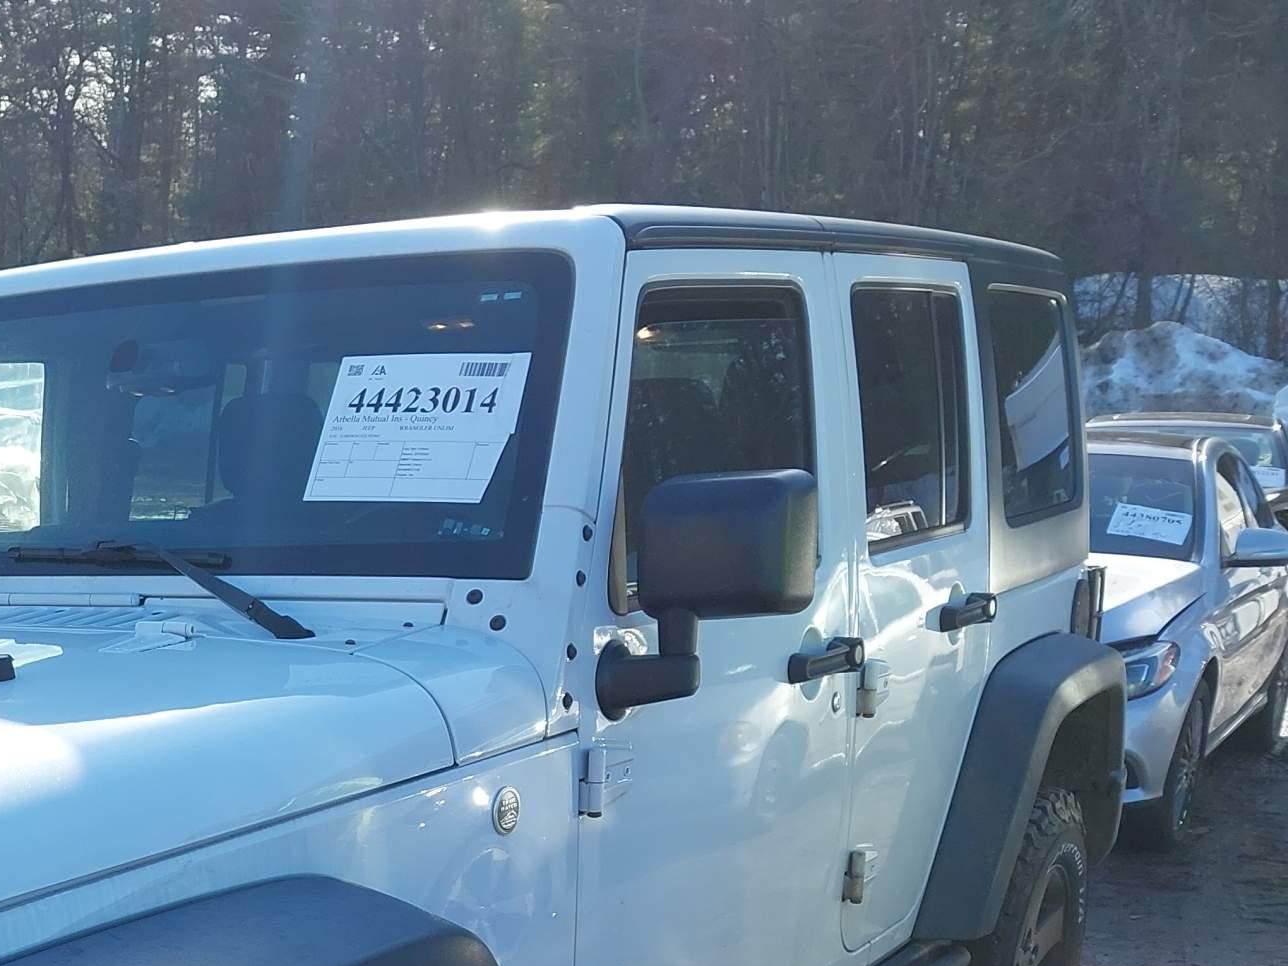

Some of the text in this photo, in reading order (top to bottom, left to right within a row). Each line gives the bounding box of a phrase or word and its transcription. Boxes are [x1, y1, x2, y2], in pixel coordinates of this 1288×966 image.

[348, 387, 499, 413] 44423014
[361, 415, 388, 423] Mutual
[410, 415, 438, 424] Quincy
